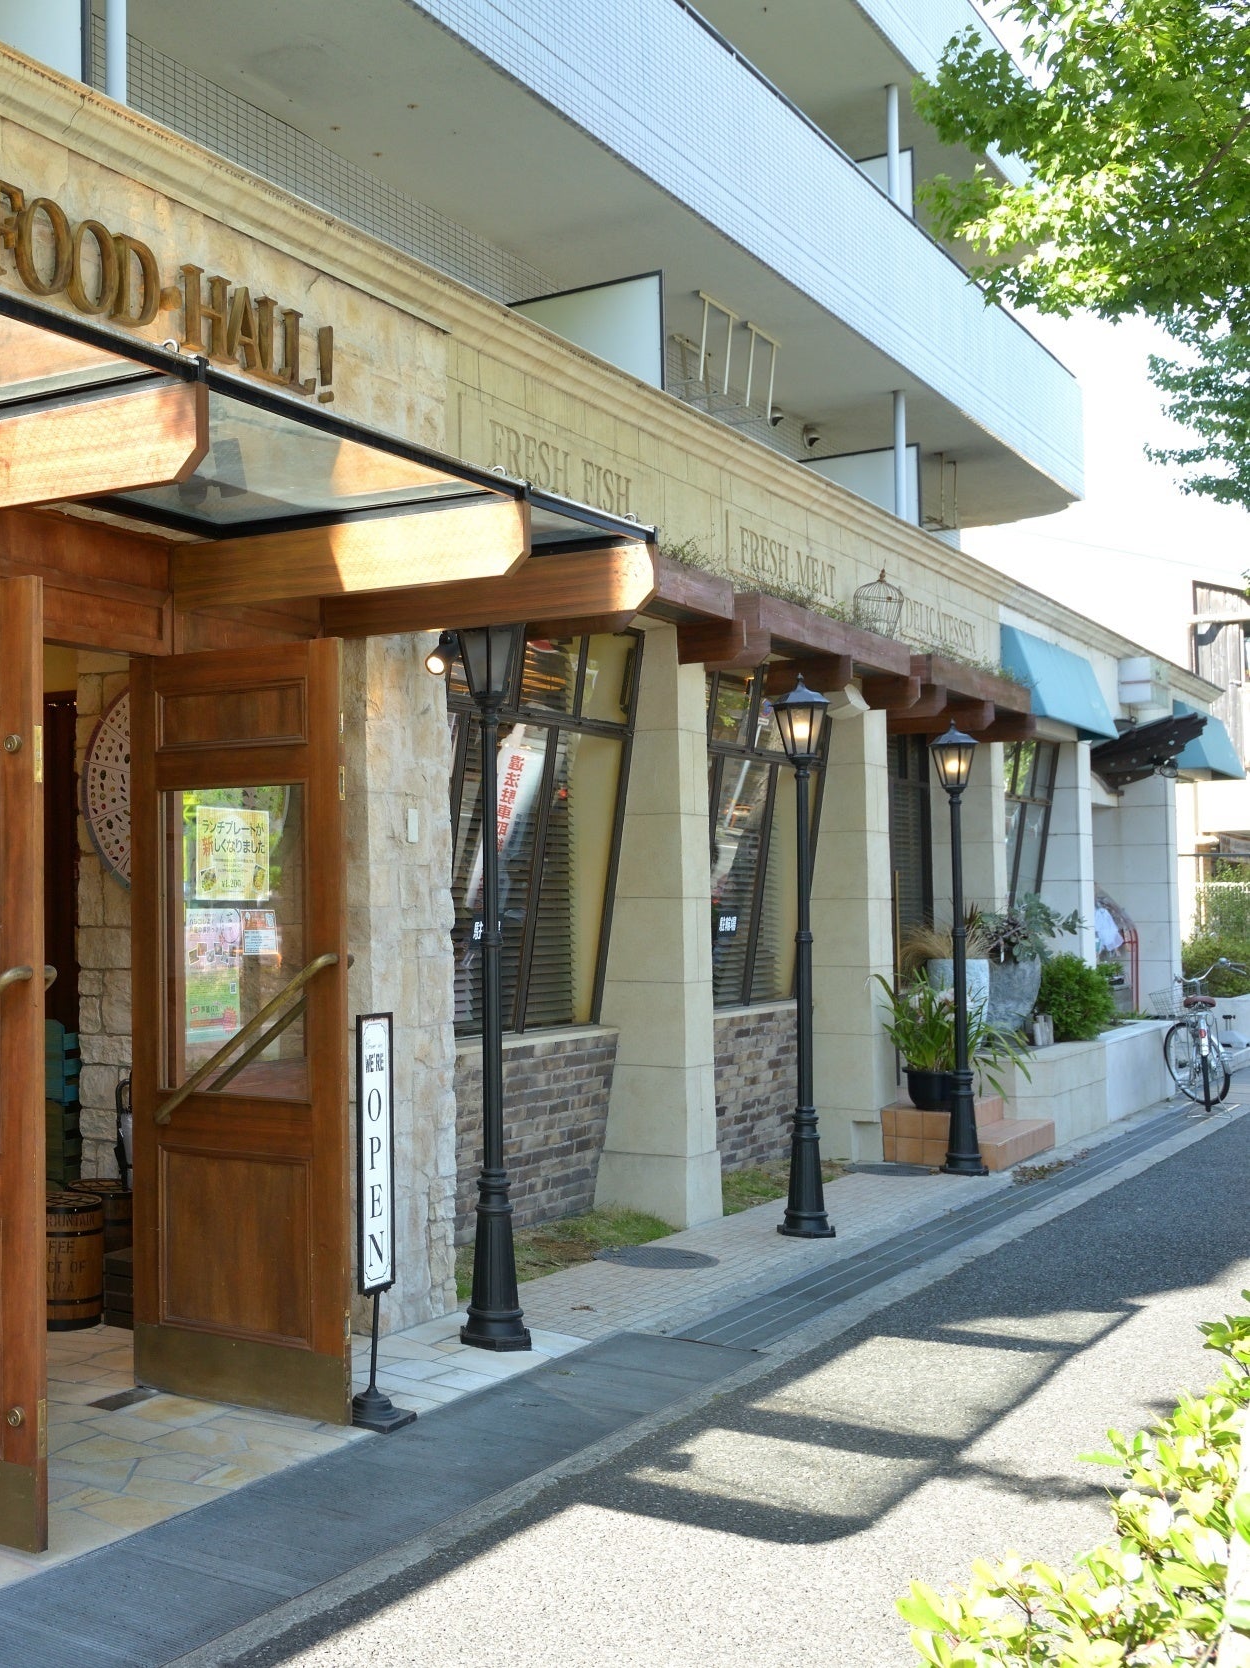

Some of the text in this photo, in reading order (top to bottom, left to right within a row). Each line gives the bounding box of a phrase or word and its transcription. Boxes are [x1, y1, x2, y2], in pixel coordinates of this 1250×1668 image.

[489, 419, 632, 518] FRESH FISH
[738, 525, 837, 599] FRESH MEAT
[905, 596, 976, 654] DELICATESSEN
[202, 819, 264, 836] ランチプレートが
[202, 836, 266, 857] 新しくなりました
[364, 1053, 384, 1073] WE'RE
[367, 1087, 385, 1268] OPEN
[69, 1260, 86, 1274] OF
